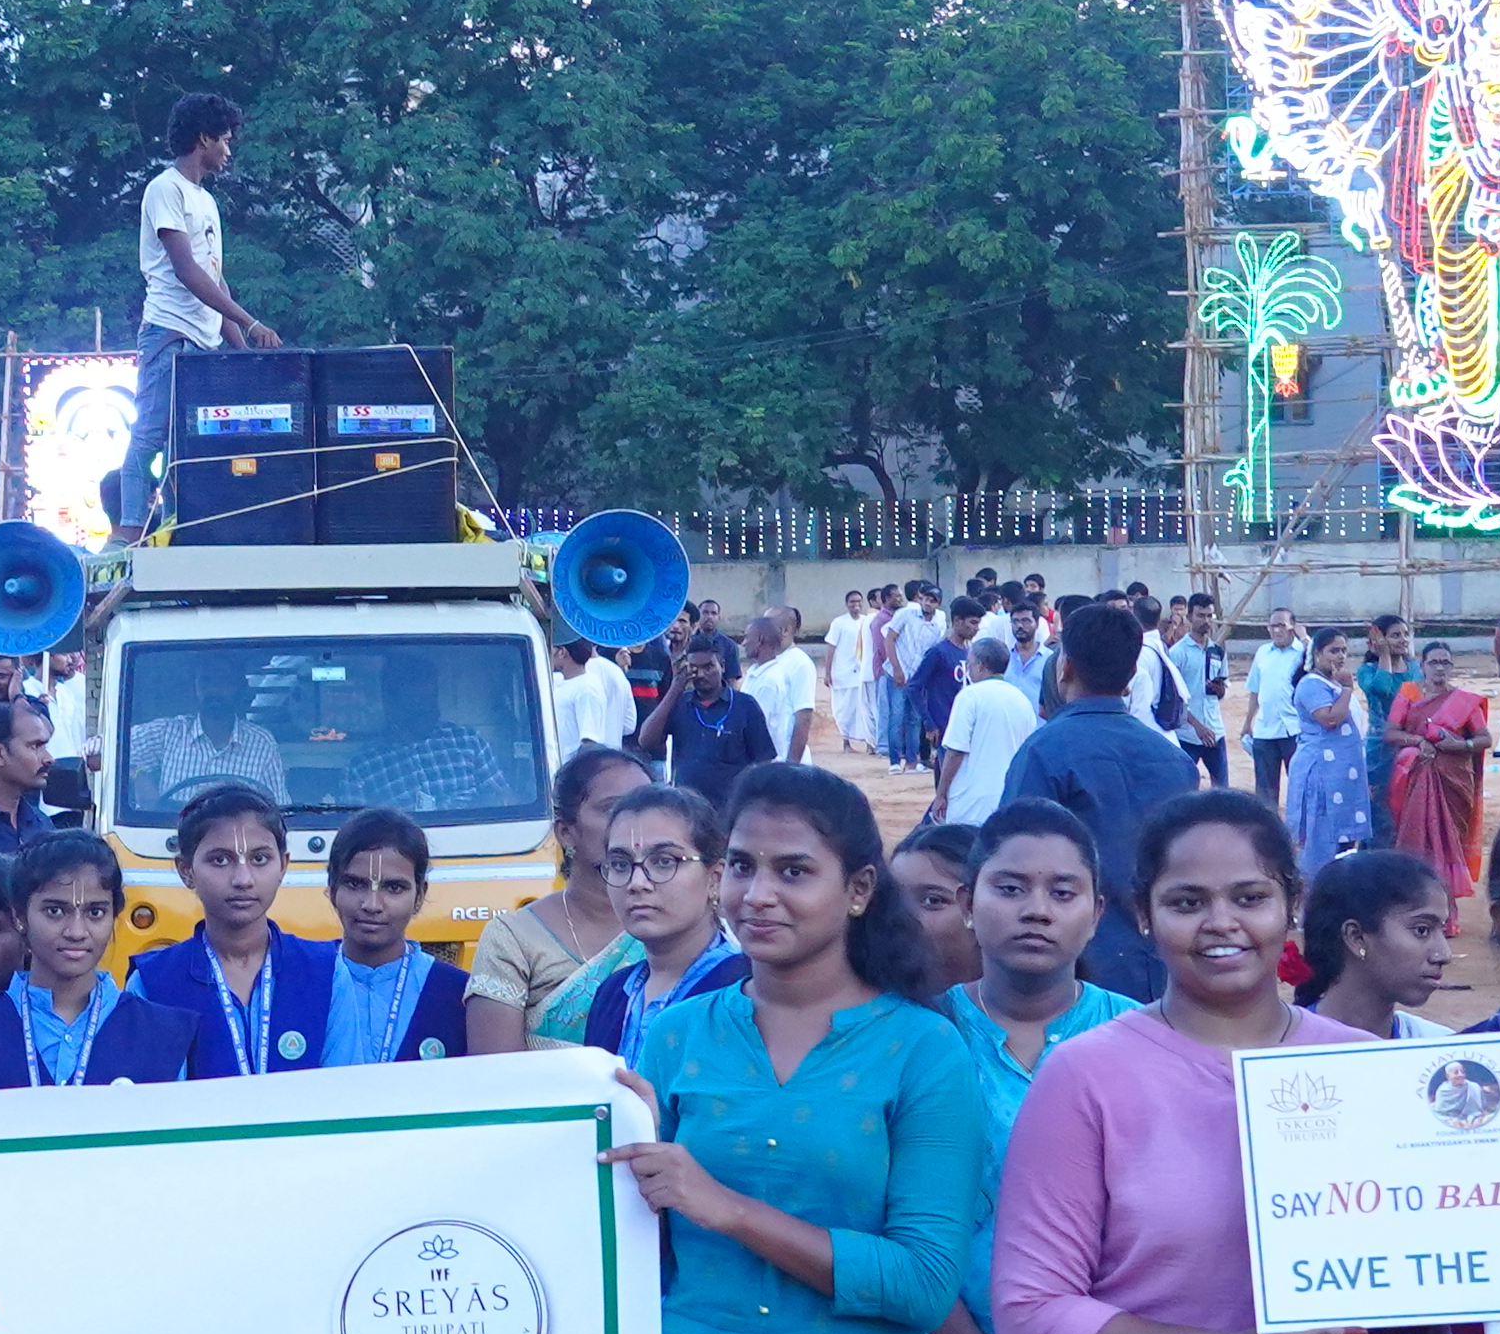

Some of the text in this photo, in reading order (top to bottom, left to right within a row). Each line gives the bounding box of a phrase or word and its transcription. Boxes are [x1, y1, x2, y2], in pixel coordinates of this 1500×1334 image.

[452, 906, 489, 920] ACE
[1276, 1117, 1337, 1131] ISKCON
[1270, 1191, 1324, 1219] SAY
[1323, 1179, 1383, 1216] NO
[1386, 1185, 1424, 1213] TO
[431, 1268, 450, 1282] IYF
[1291, 1255, 1391, 1293] SAVE
[1405, 1250, 1490, 1286] THE
